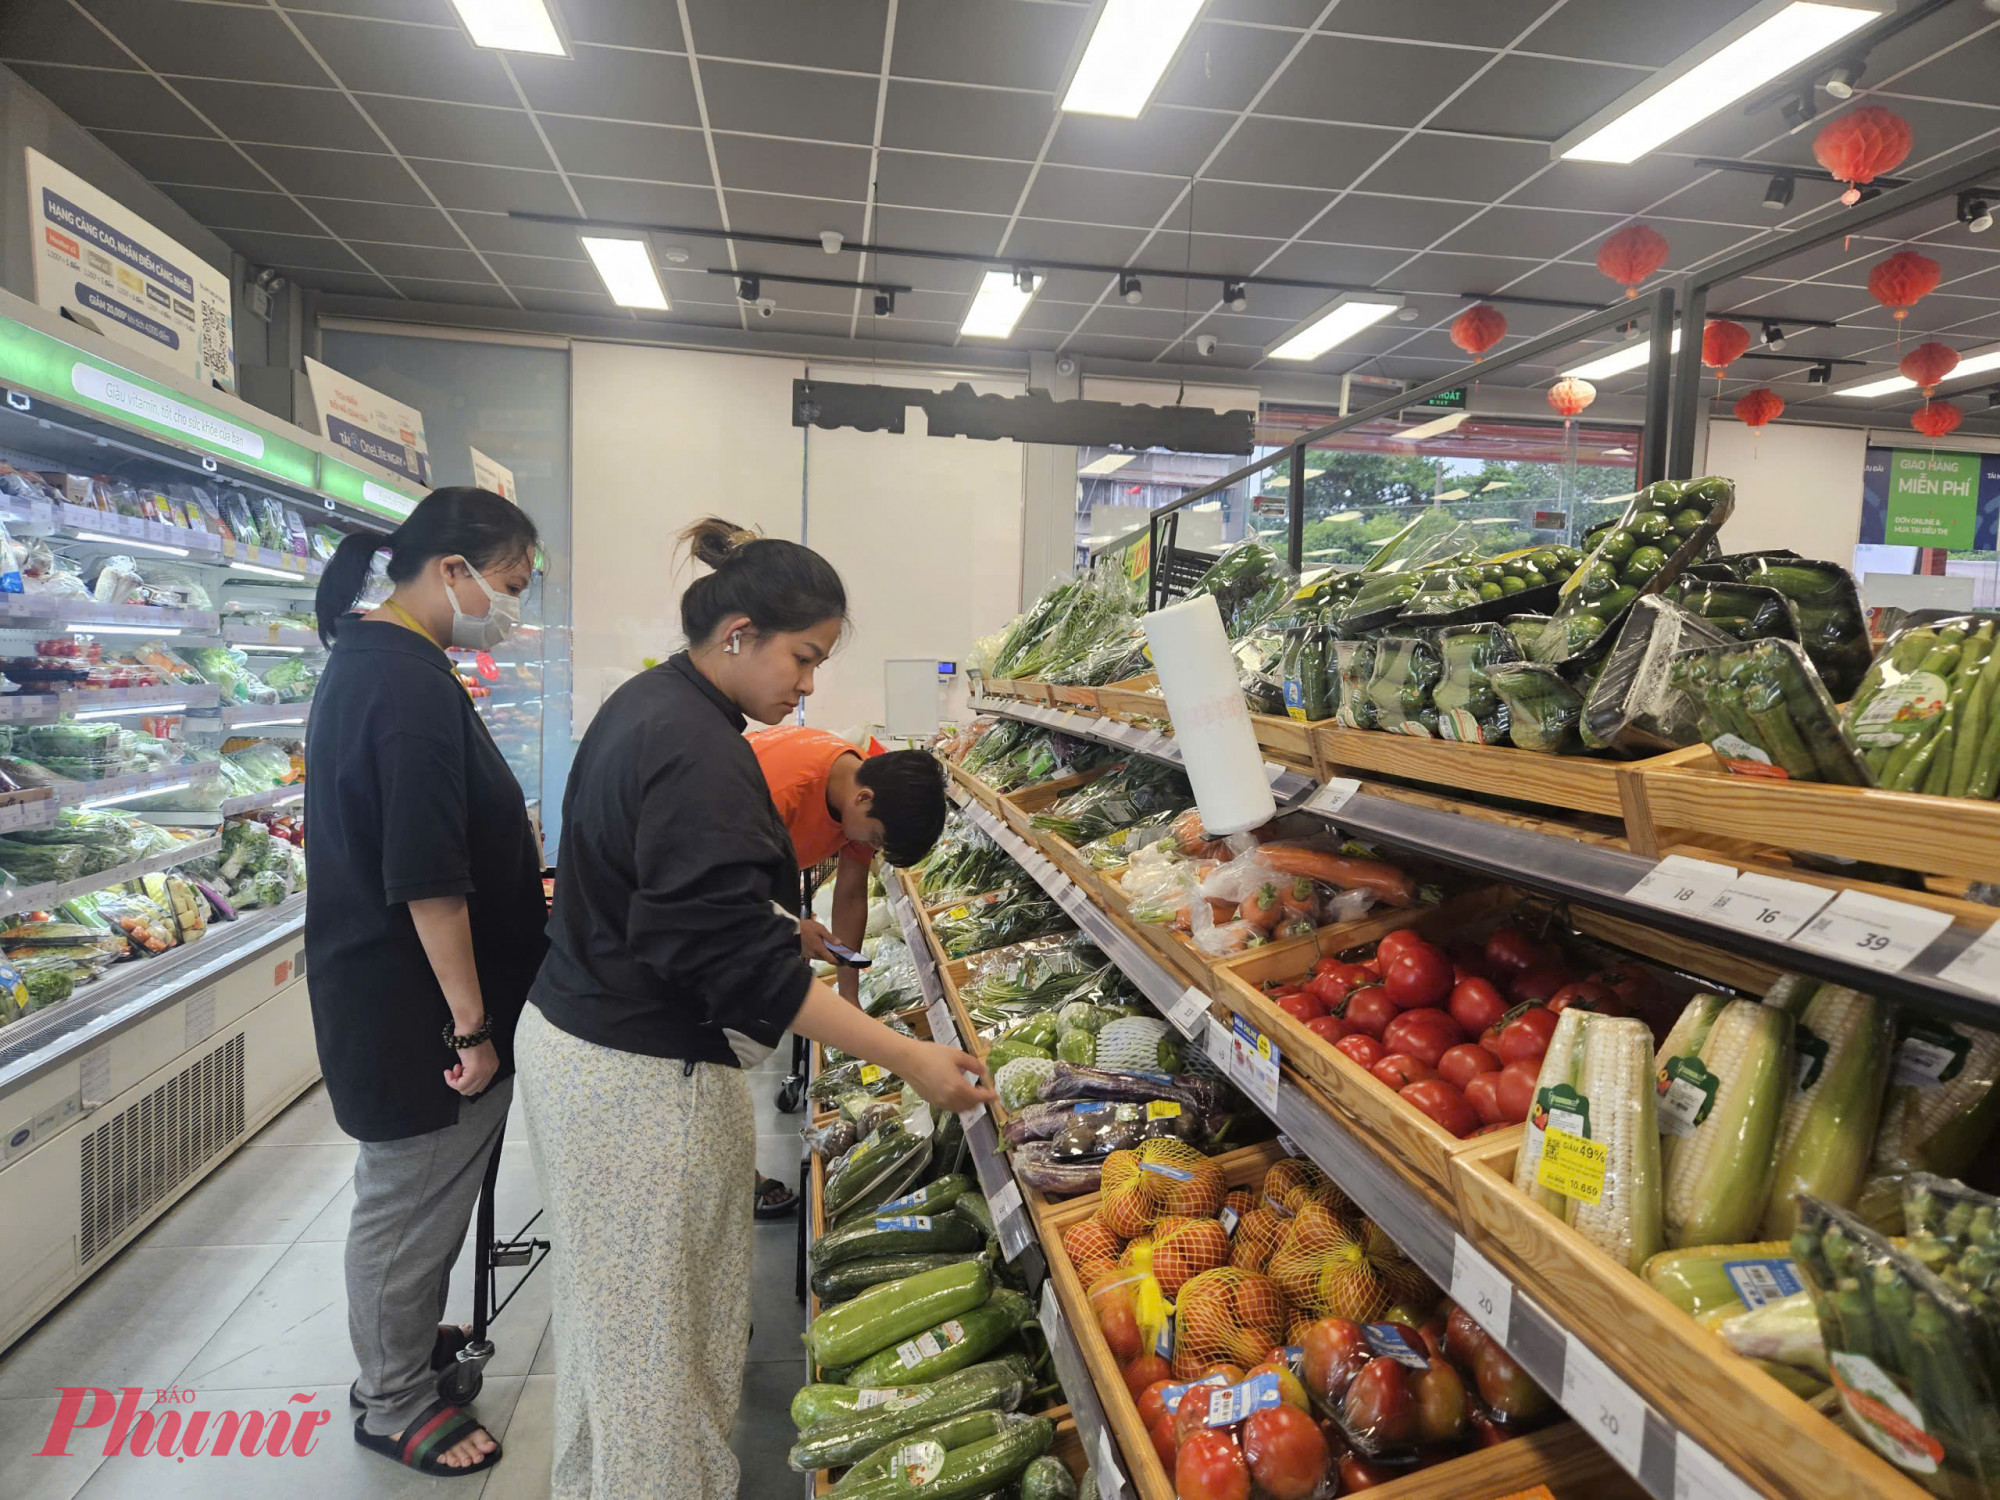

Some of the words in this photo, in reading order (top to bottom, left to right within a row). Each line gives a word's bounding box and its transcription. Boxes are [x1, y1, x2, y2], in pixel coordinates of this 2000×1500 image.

[48, 200, 74, 223] HẠNG
[75, 215, 98, 238] CÀNG
[99, 230, 116, 251] CAO,
[155, 262, 173, 281] CÀNG
[88, 294, 106, 311] GIẢM
[105, 382, 126, 403] Giàu
[128, 392, 160, 417] vitamin,
[161, 402, 173, 419] tốt
[173, 410, 187, 426] cho
[188, 416, 201, 431] sức
[360, 439, 389, 461] OneLife
[1900, 460, 1926, 470] GIAO
[1928, 458, 1959, 473] HÀNG
[1898, 473, 1939, 495] MIỄN
[1942, 477, 1972, 497] PHÍ
[1673, 887, 1695, 901] 18
[1755, 908, 1781, 924] 16
[1856, 932, 1890, 951] 39
[1579, 1145, 1605, 1163] 49%
[1478, 1291, 1493, 1316] 20
[1601, 1407, 1619, 1436] 20
